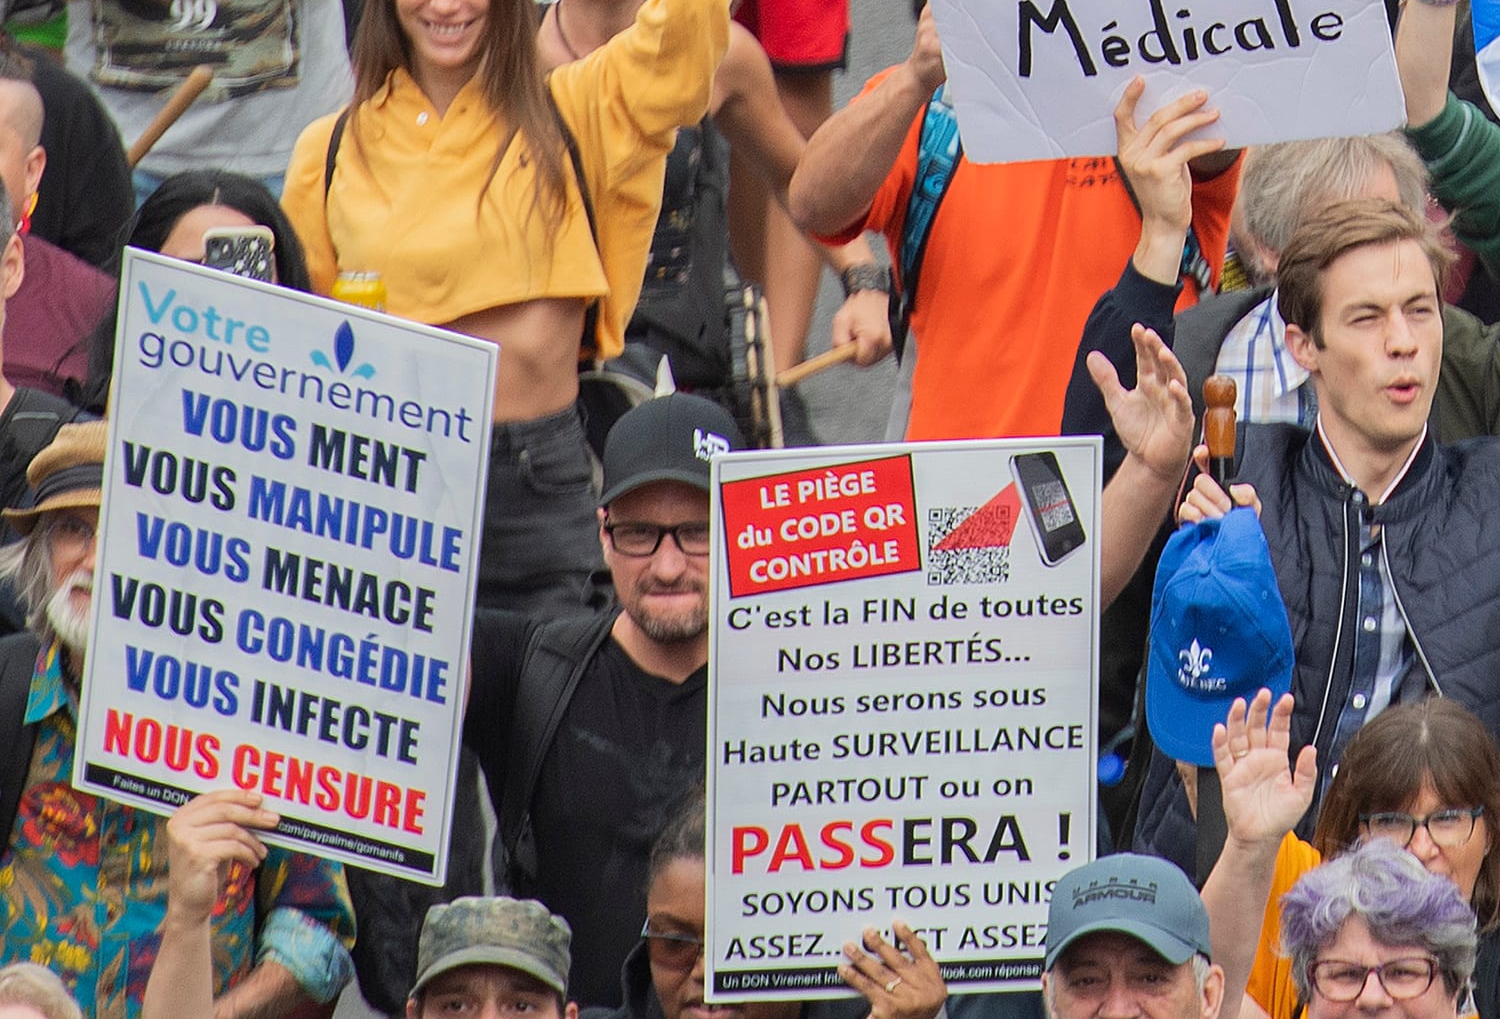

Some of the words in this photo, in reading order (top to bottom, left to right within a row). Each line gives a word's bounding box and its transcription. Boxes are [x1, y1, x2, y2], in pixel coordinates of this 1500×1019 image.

[138, 279, 271, 354] Votre
[138, 331, 474, 444] gouvernement
[181, 387, 297, 460] VOUS
[307, 422, 427, 494] MENT
[122, 439, 237, 512] VOUS
[247, 474, 464, 574] MANIPULE
[759, 483, 792, 511] LE
[798, 469, 877, 503] PIÈGE
[737, 525, 773, 550] du
[780, 510, 857, 543] CODE
[864, 502, 906, 531] QR
[136, 511, 251, 584] VOUS
[261, 546, 436, 634] MENACE
[749, 538, 900, 584] CONTRÔLE
[110, 572, 225, 644] VOUS
[236, 608, 449, 705] CONGÉDIE
[727, 604, 812, 631] C'est
[823, 600, 850, 627] la
[862, 597, 917, 624] FIN
[928, 594, 969, 621] de
[979, 594, 1084, 619] toutes
[777, 648, 841, 672] Nos
[852, 631, 1032, 669] LIBERTÉS...
[125, 644, 240, 717] VOUS
[250, 679, 421, 766] INFECTE
[761, 693, 845, 719] Nous
[856, 690, 962, 713] serons
[973, 687, 1047, 708] sous
[103, 708, 221, 780] NOUS
[231, 743, 426, 836] CENSURE
[723, 738, 821, 766] Haute
[832, 725, 1085, 760] SURVEILLANCE
[771, 775, 929, 807] PARTOUT
[939, 777, 980, 798] ou
[992, 777, 1034, 797] on
[113, 776, 145, 796] Faites
[146, 786, 161, 799] un
[161, 789, 190, 806] DON
[278, 820, 405, 863] com/paypalme/gomanifs
[731, 814, 1032, 875] PASSERA
[742, 887, 875, 917] SOYONS
[886, 883, 971, 909] TOUS
[983, 880, 1057, 905] UNIS
[722, 975, 740, 989] Un
[742, 973, 769, 988] DON
[771, 970, 821, 987] Virement
[939, 964, 992, 981] look.com
